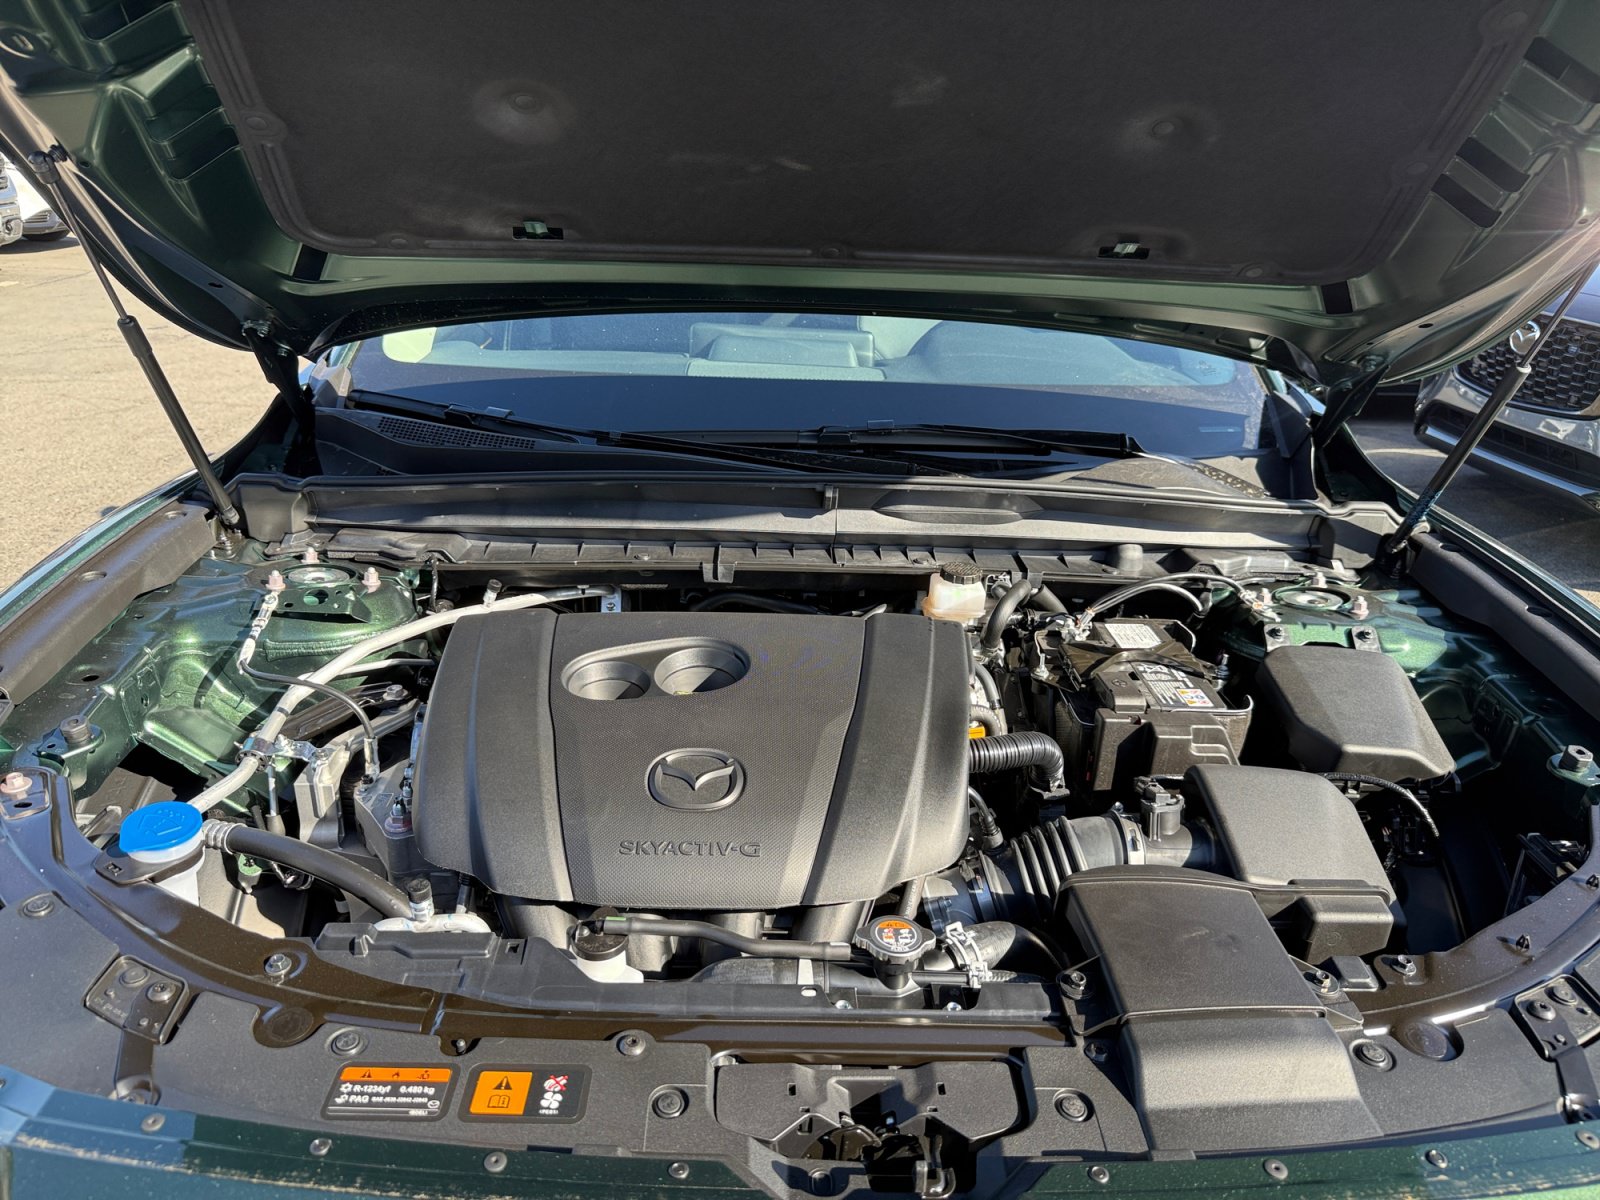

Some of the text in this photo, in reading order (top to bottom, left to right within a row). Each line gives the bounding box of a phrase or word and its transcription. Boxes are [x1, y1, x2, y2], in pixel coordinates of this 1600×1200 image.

[618, 840, 761, 858] SKYACTIV-G
[353, 1084, 392, 1095] R-1234yf
[423, 1086, 435, 1095] kg
[349, 1095, 369, 1104] PAG
